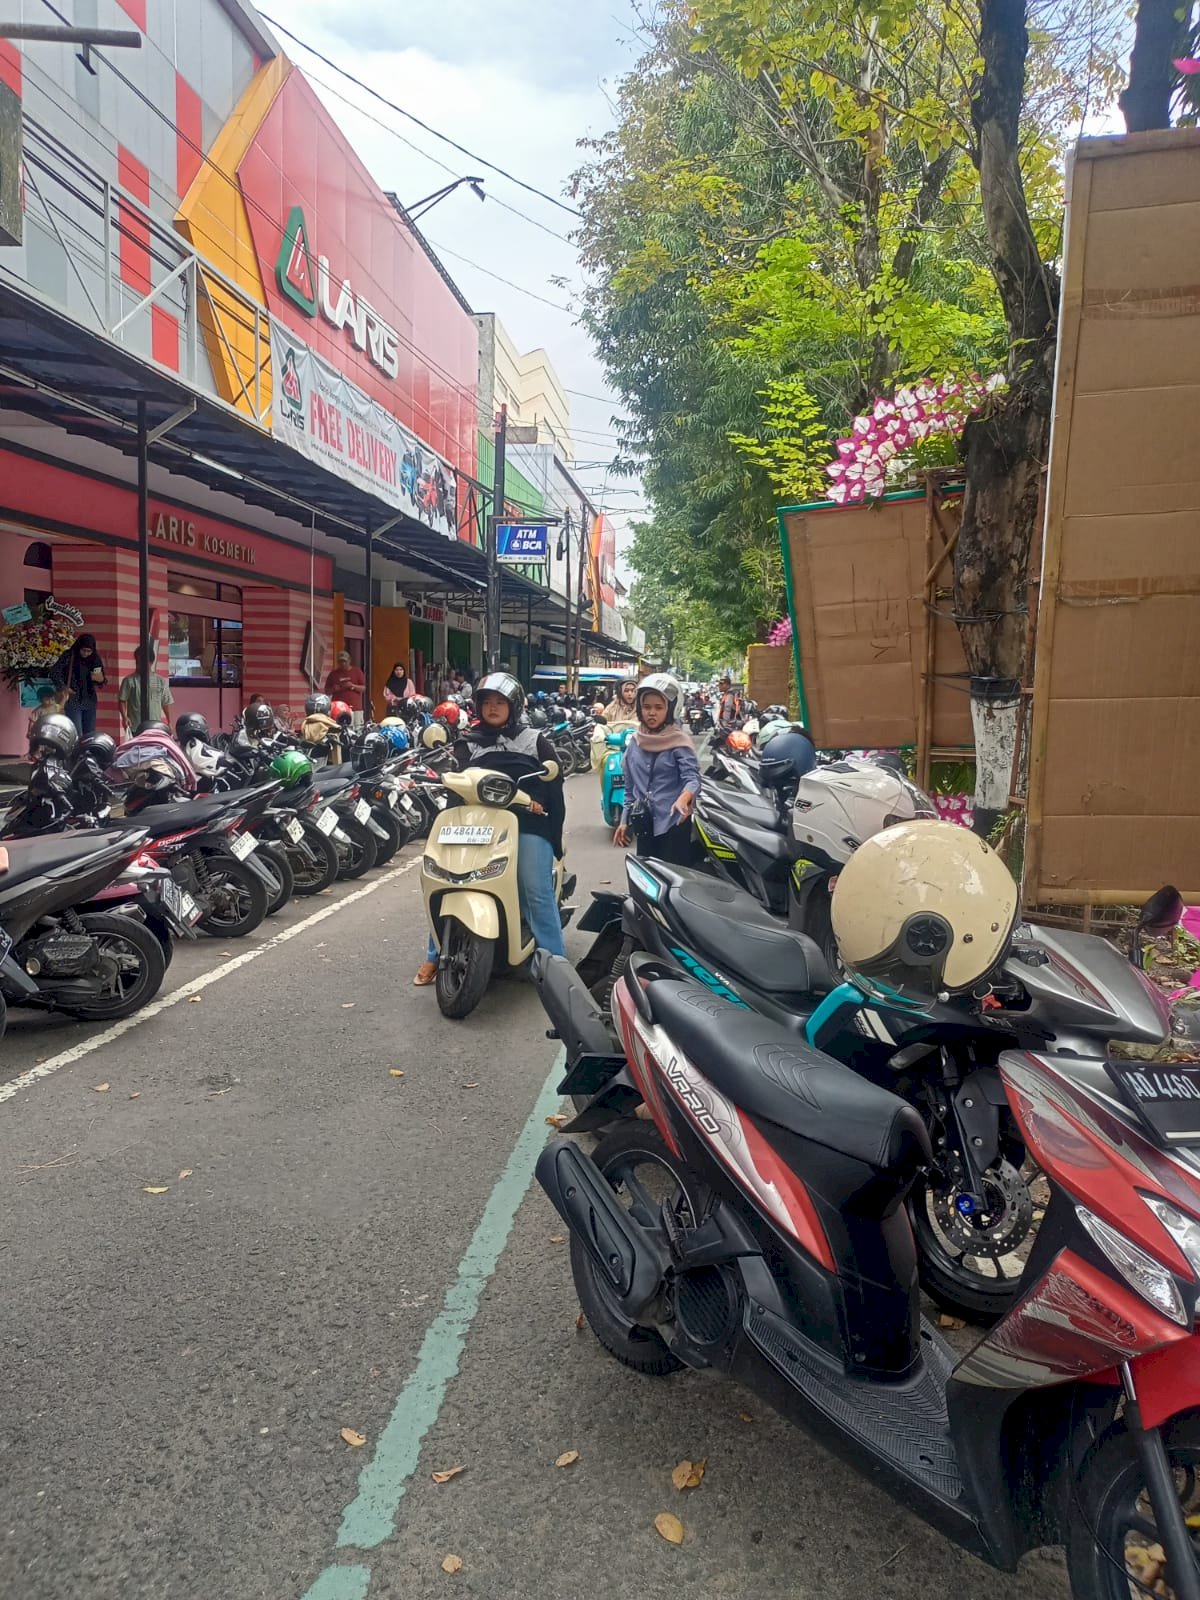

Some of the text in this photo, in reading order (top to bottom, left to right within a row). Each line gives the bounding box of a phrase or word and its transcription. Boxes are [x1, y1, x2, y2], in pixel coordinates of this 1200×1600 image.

[318, 255, 399, 379] LARIS
[310, 389, 344, 453] FREE
[346, 416, 397, 488] DELIVERY
[147, 513, 257, 564] ARIS KOSMETIK
[516, 529, 538, 539] ATM
[522, 540, 542, 550] BCA
[441, 827, 452, 836] AD
[666, 1055, 722, 1135] VARIO
[1125, 1071, 1158, 1098] AD
